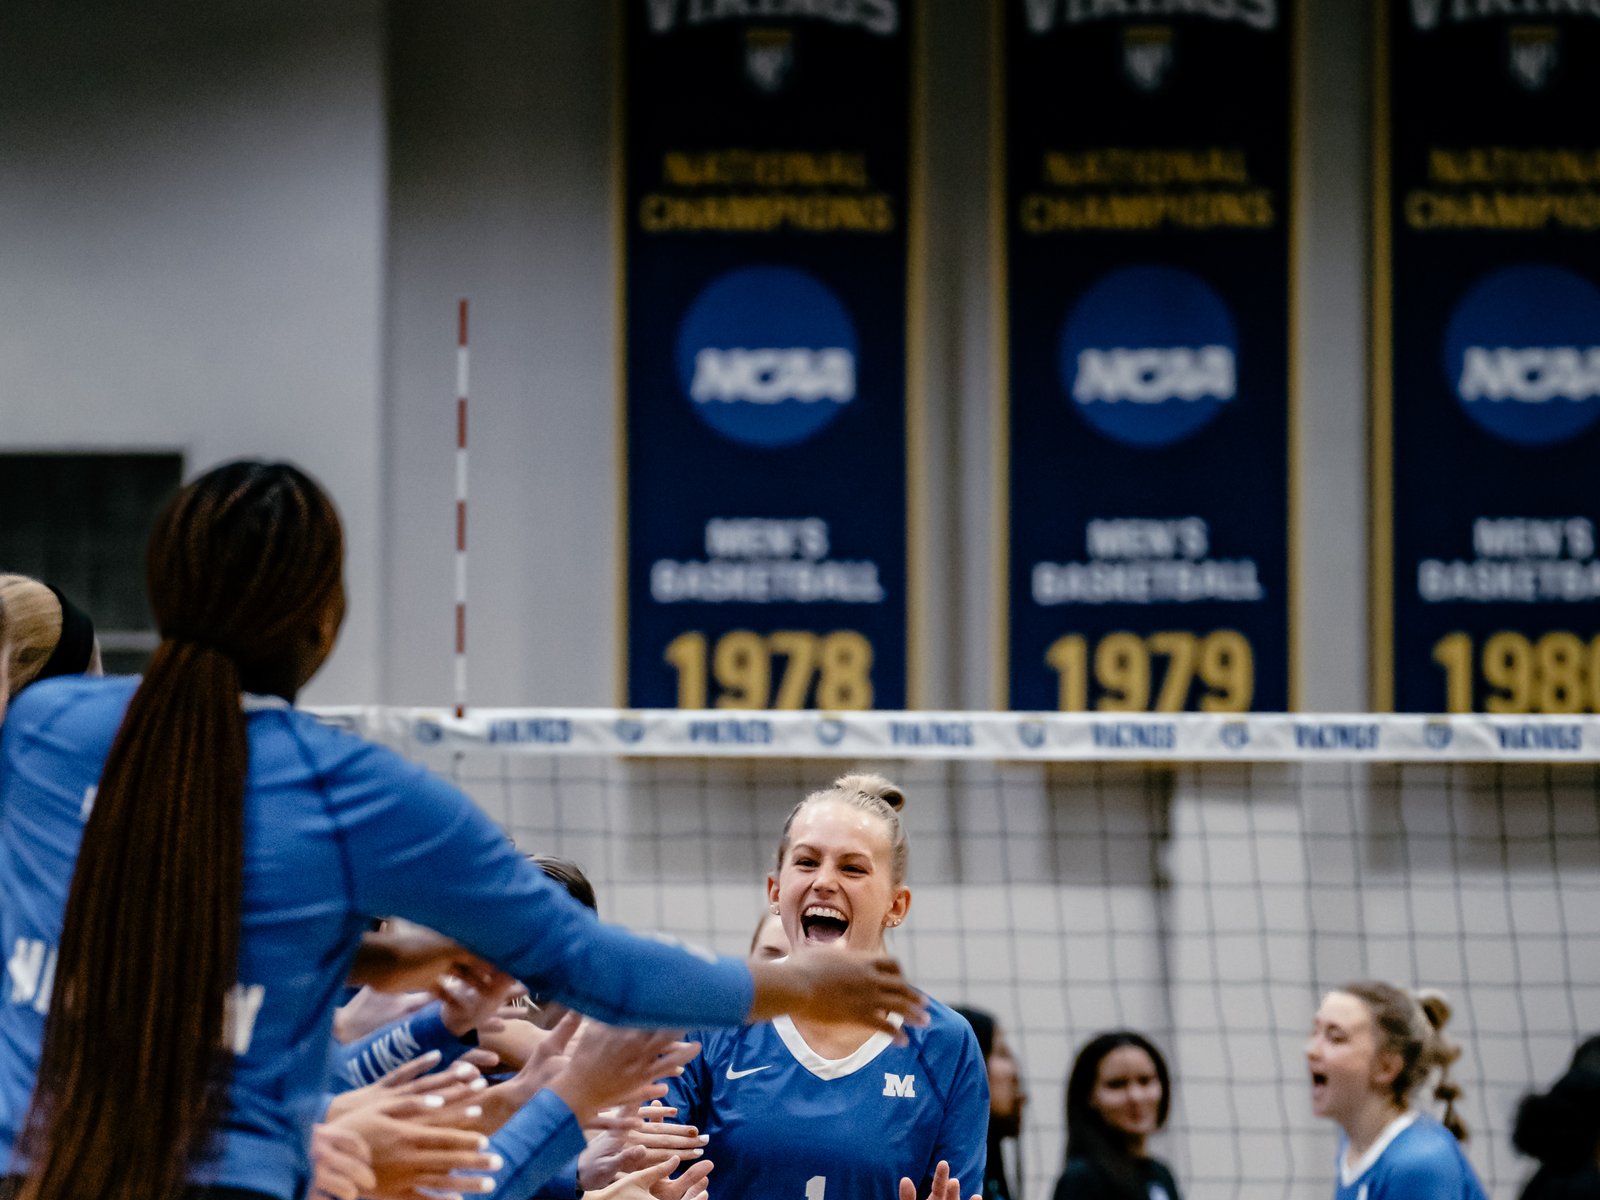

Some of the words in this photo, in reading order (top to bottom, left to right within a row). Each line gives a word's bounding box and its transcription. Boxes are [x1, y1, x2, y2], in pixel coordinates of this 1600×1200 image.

[691, 347, 856, 403] NCAA
[1073, 345, 1236, 403] NCAA
[705, 518, 829, 558] MEN'S
[1086, 518, 1208, 558] MEN'S
[1472, 517, 1595, 557] MEN'S
[650, 560, 883, 602] BASKETBALL
[1032, 560, 1262, 603] BASKETBALL
[664, 630, 873, 711] 1978
[1045, 630, 1254, 712] 1979
[1431, 632, 1600, 712] 198
[882, 1072, 916, 1098] M
